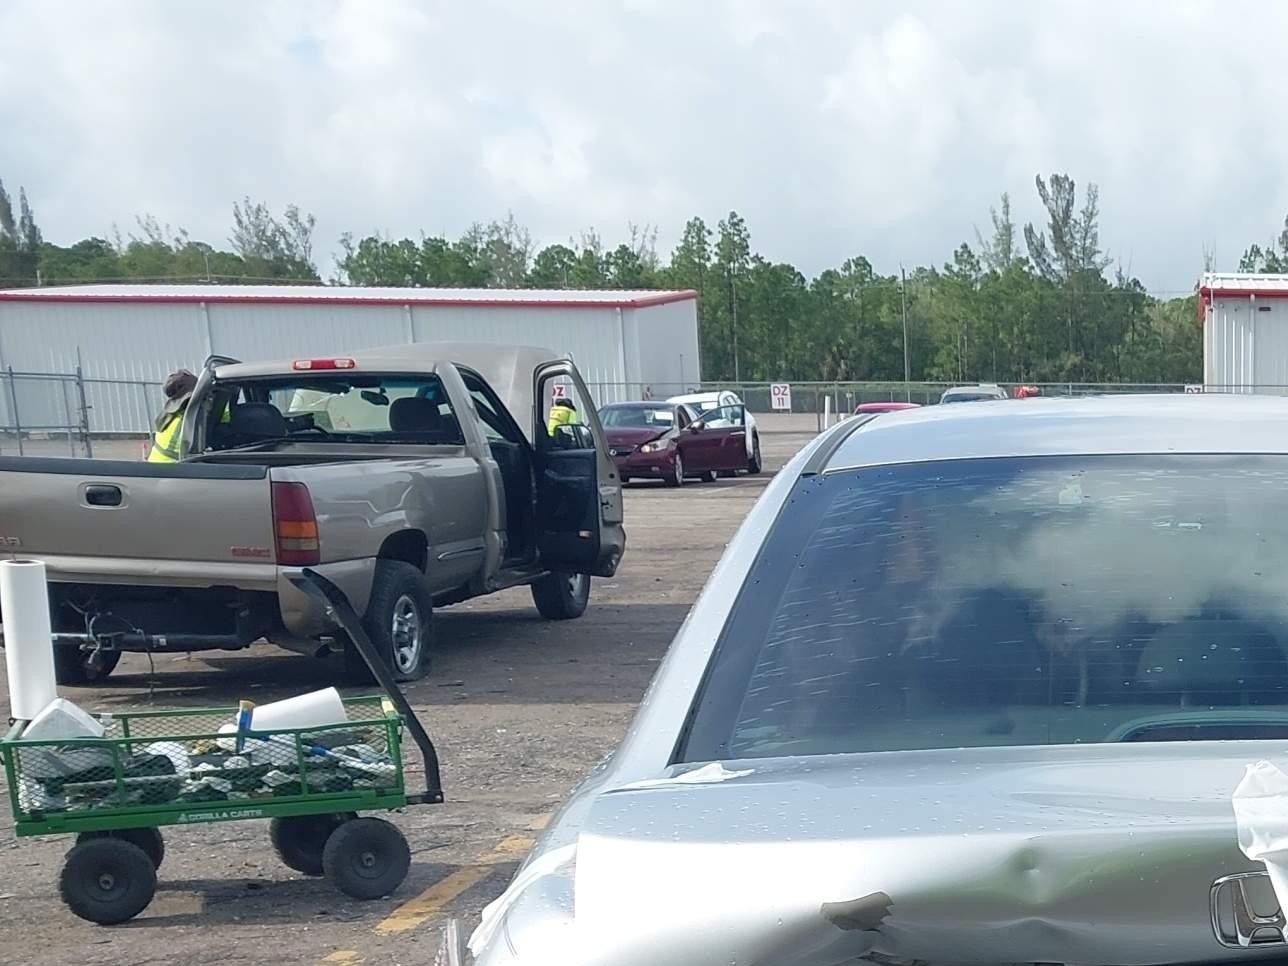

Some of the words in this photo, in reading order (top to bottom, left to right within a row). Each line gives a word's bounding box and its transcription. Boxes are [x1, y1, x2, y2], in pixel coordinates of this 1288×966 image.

[772, 385, 788, 396] DZ
[776, 396, 785, 407] 11
[188, 811, 229, 822] GORILLA
[230, 809, 262, 818] CARTS
